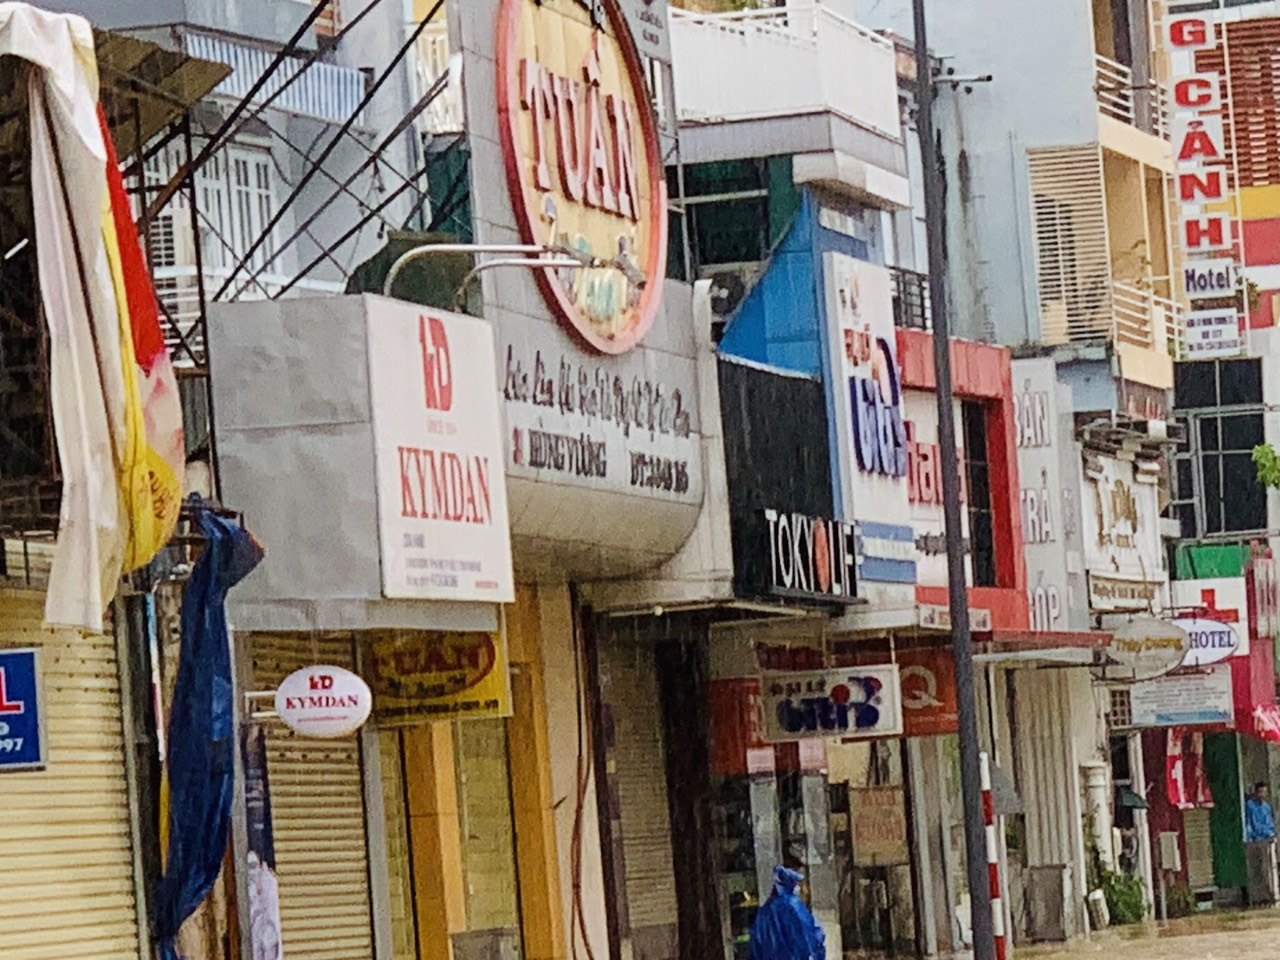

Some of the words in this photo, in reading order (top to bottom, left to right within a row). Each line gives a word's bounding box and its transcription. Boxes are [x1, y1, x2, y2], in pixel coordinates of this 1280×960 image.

[397, 445, 492, 526] KYMDAN
[1188, 630, 1235, 649] HOTEL
[286, 694, 359, 710] KYMDAN
